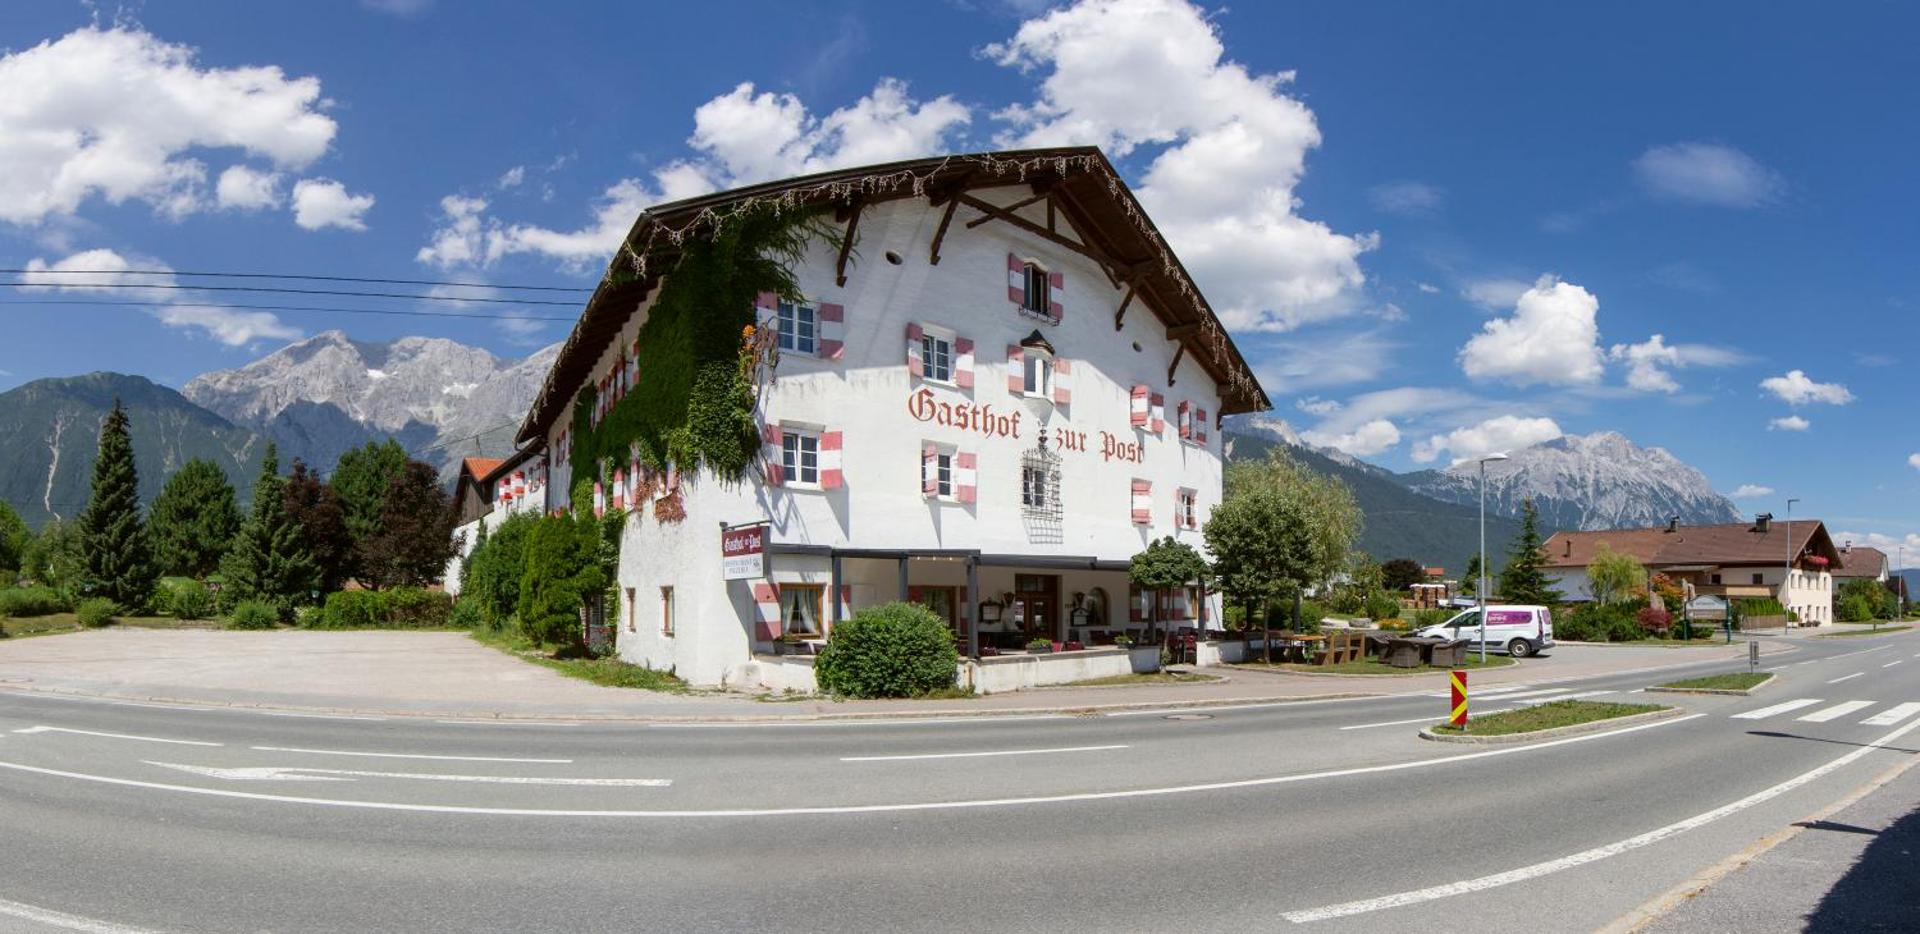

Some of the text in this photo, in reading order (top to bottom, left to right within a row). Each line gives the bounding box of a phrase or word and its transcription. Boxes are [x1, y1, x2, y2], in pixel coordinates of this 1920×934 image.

[908, 388, 1145, 464] Gasthof zur Post
